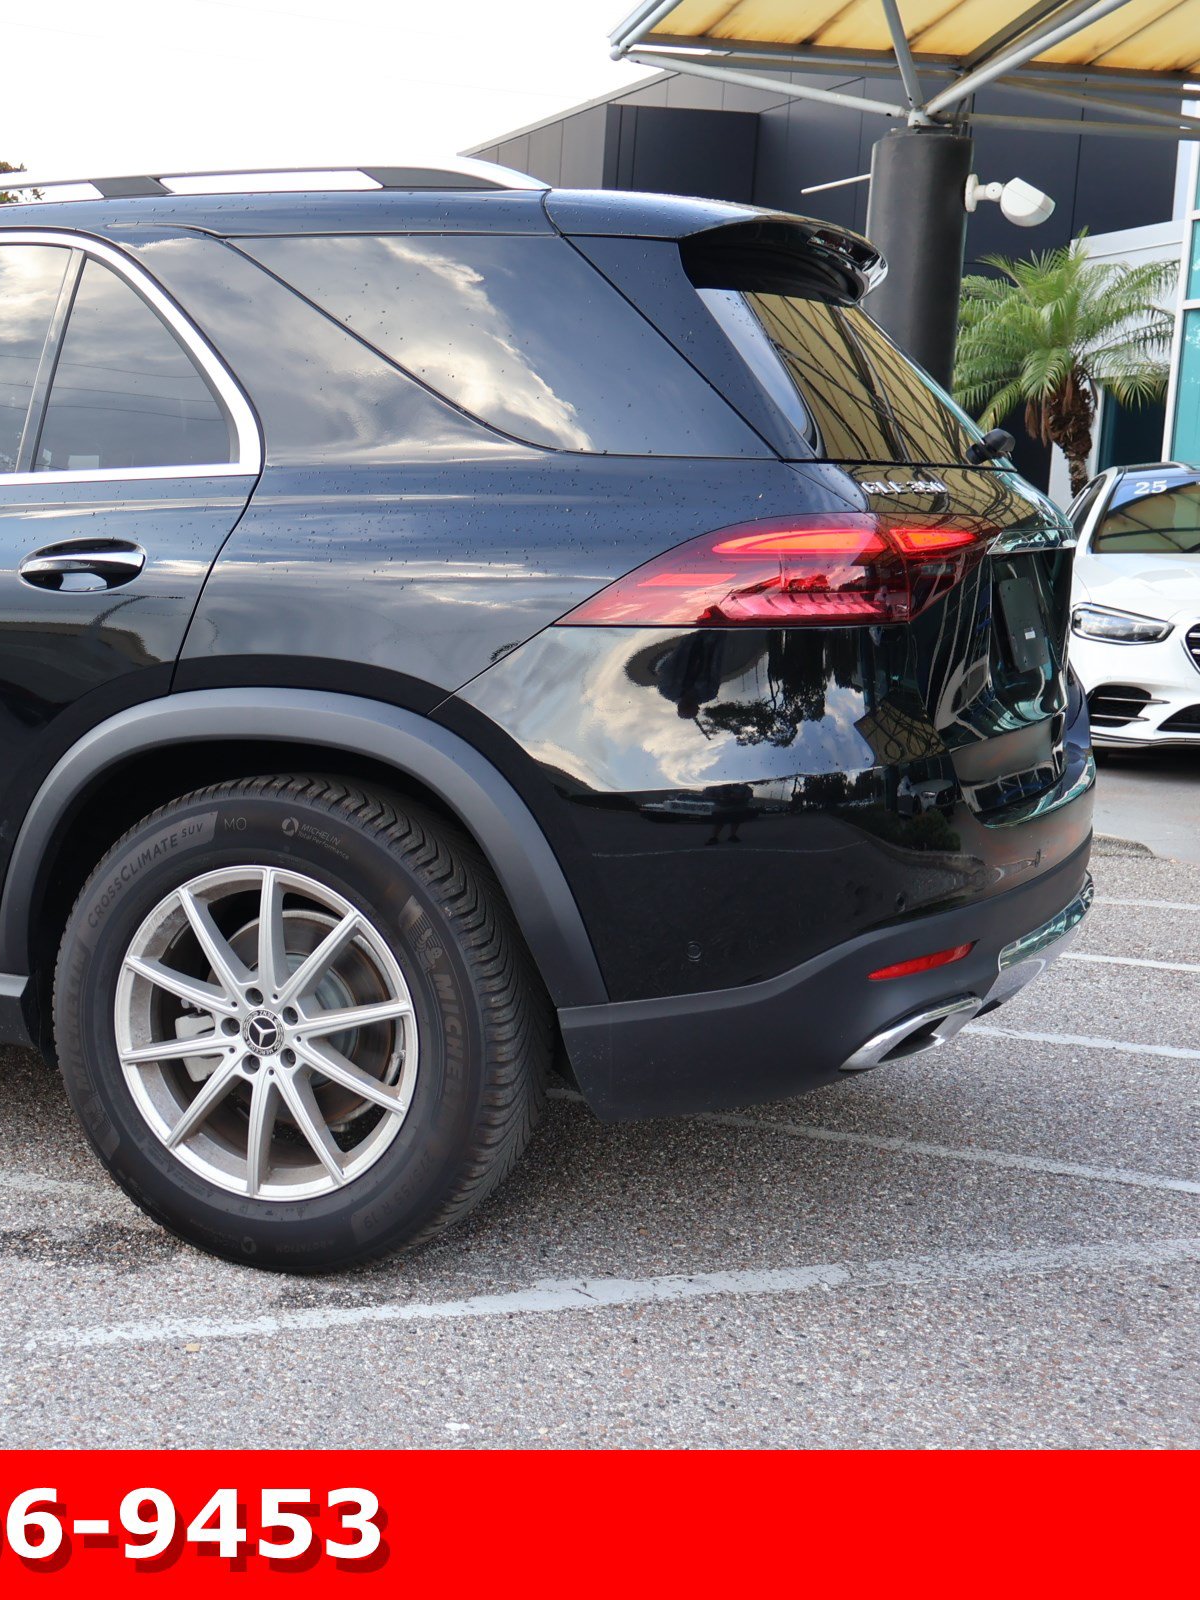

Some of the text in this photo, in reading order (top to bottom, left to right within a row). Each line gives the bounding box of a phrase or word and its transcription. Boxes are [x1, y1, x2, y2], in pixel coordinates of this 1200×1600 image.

[861, 480, 905, 495] GLE
[1134, 479, 1168, 495] 25
[224, 816, 248, 832] MO
[301, 823, 341, 846] MICHELIN
[87, 822, 204, 929] CROSSCLIMATE SUV
